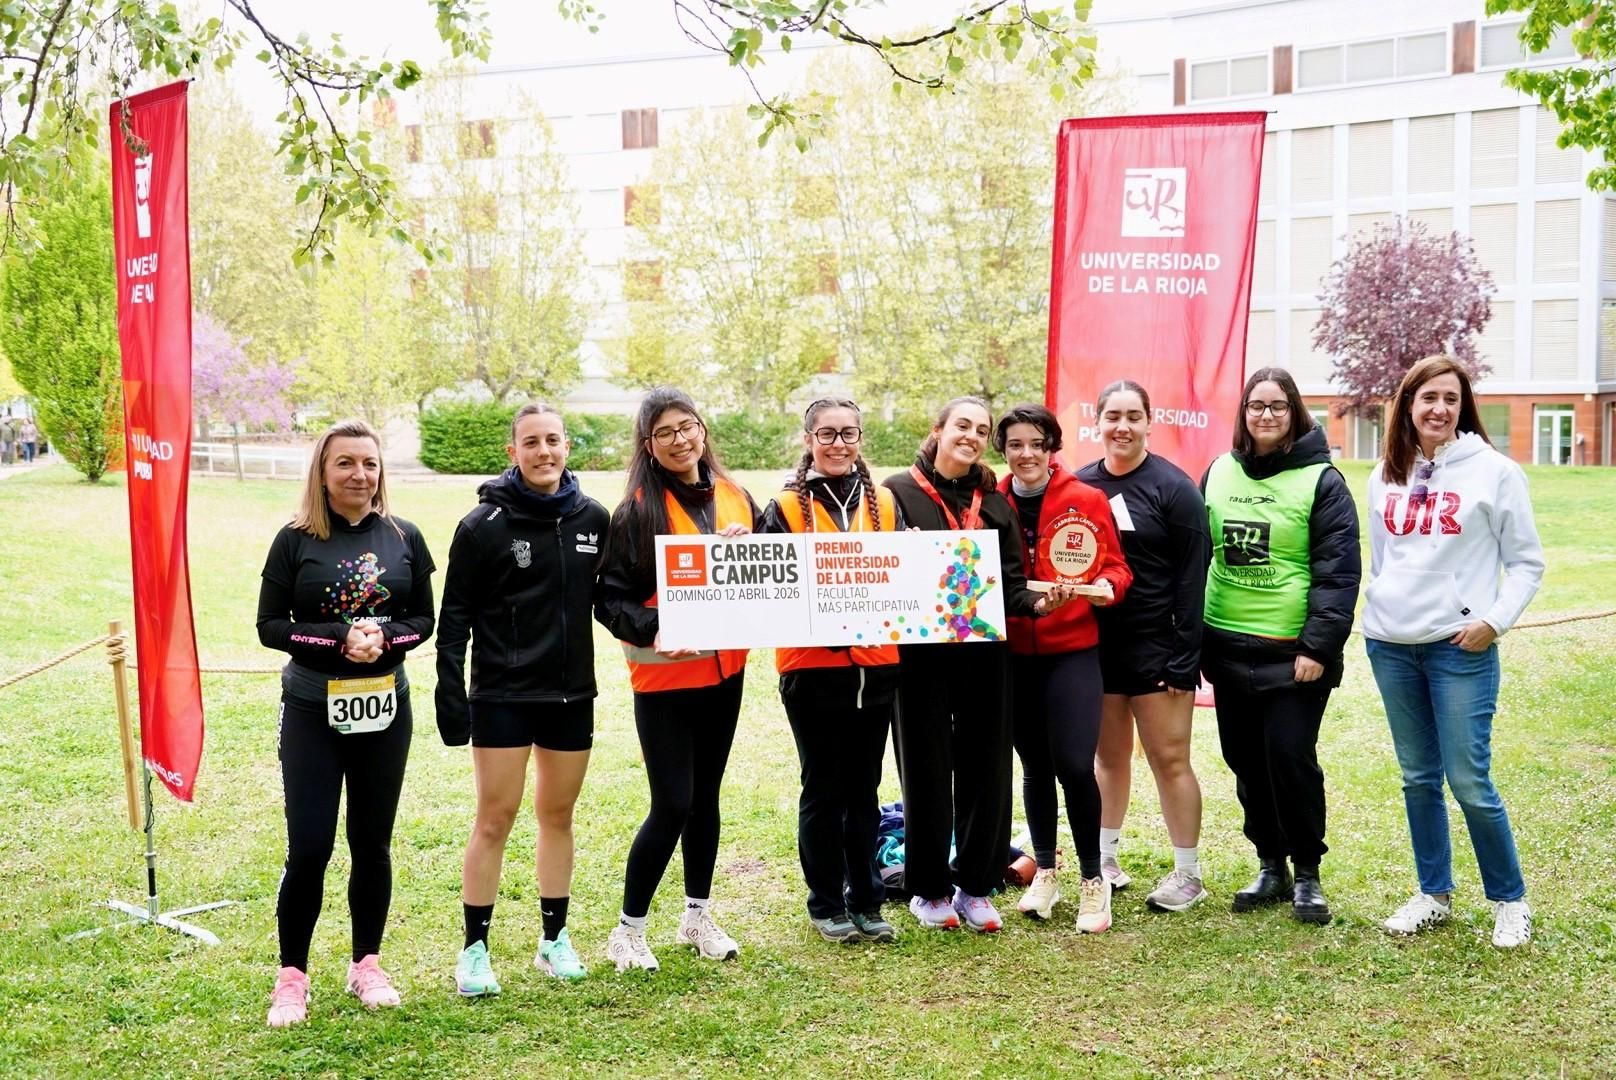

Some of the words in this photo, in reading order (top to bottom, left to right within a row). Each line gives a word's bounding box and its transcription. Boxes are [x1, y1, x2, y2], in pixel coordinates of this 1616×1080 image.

[1081, 252, 1220, 271] UNIVERSIDAD
[1088, 275, 1114, 293] DE
[1121, 275, 1149, 293] LA
[1156, 276, 1208, 299] RIOJA
[1054, 516, 1079, 529] CARRERA
[711, 543, 797, 562] CARRERA
[815, 542, 863, 554] PREMIO
[1054, 550, 1091, 559] UNIVERSIDAD
[815, 556, 900, 569] UNIVERSIDAD
[712, 563, 799, 585] CAMPUS
[816, 572, 833, 585] DE
[836, 572, 852, 584] LA
[855, 571, 890, 584] RIOJA
[1223, 566, 1276, 577] UNIVERSIDAD
[667, 589, 721, 602] DOMINGO
[726, 588, 735, 600] 12
[739, 588, 771, 600] ABRIL
[774, 587, 800, 599] 2026
[817, 586, 869, 599] FACULTAD
[844, 599, 920, 613] PARTICIPATIVA
[333, 693, 393, 722] 3004
